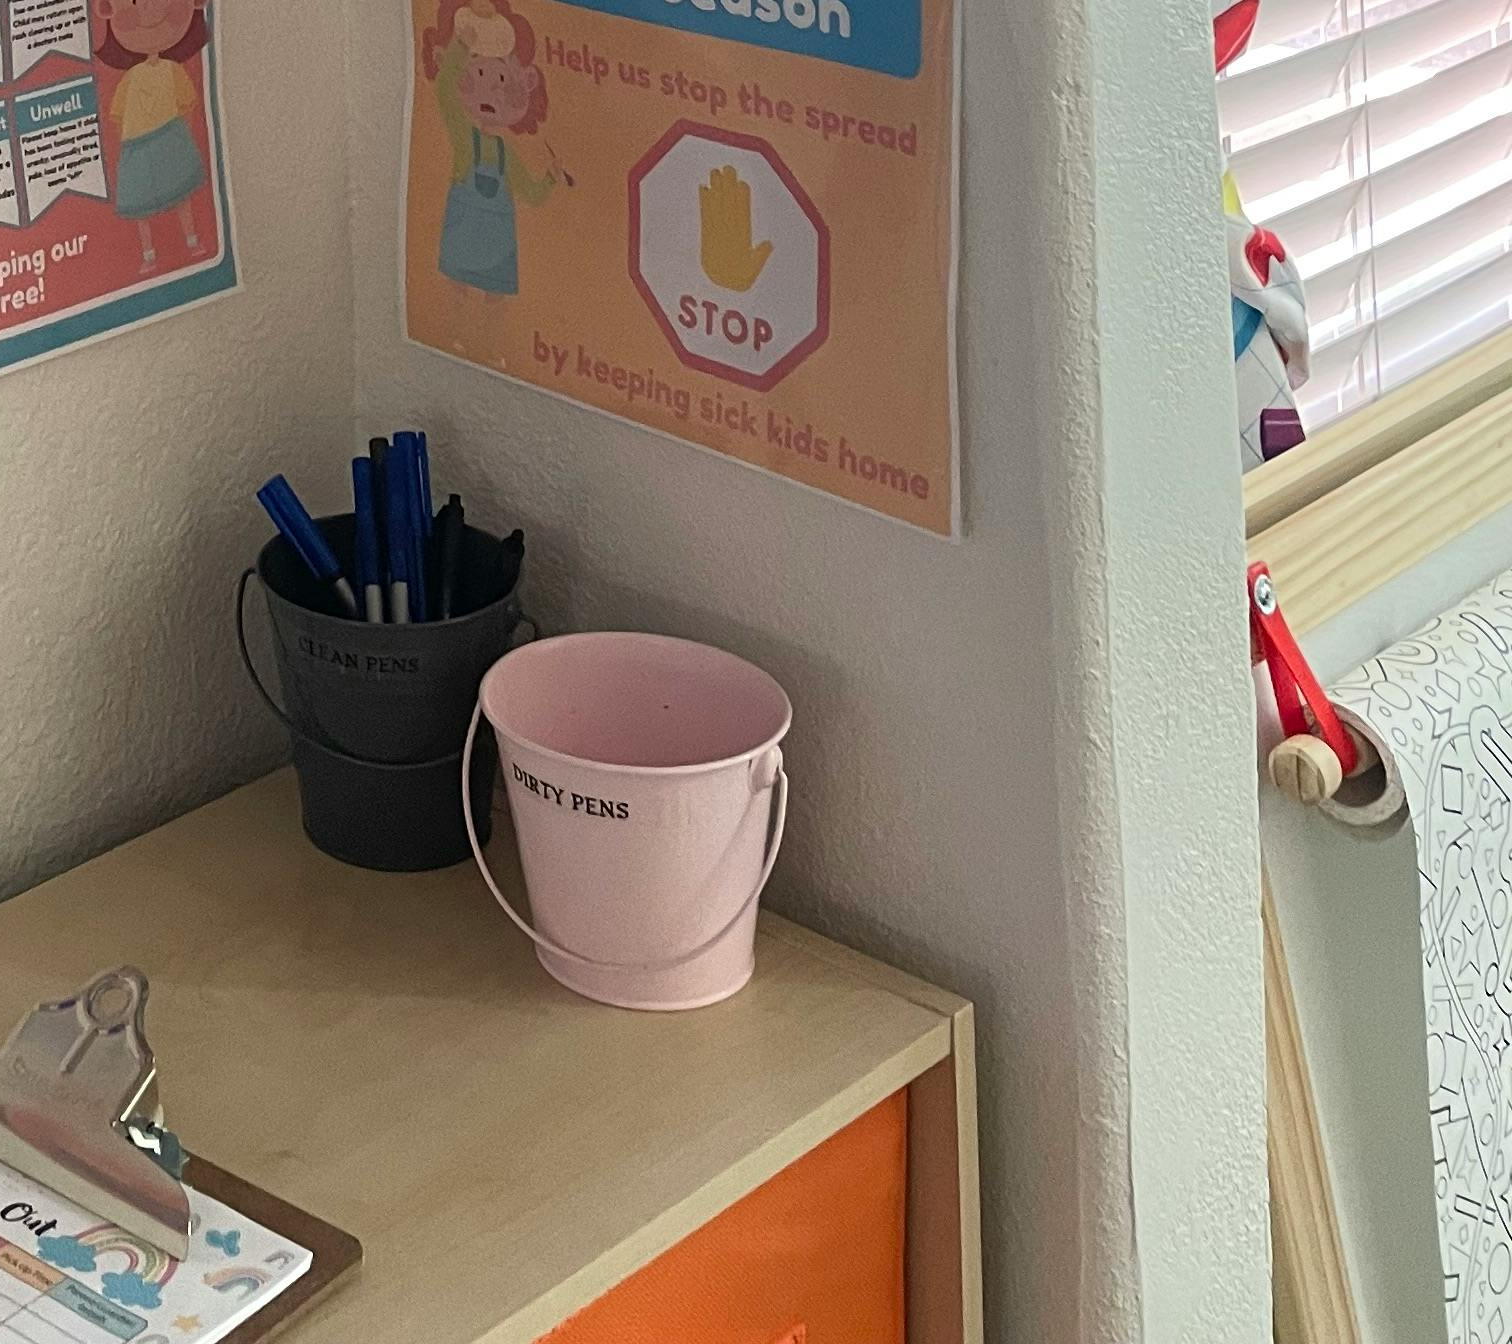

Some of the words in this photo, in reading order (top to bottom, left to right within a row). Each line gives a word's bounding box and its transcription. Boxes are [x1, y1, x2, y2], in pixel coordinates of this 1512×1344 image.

[30, 93, 83, 122] Unwell
[544, 36, 609, 82] Help
[619, 61, 650, 89] us
[660, 71, 727, 114] stop
[739, 82, 793, 123] the
[805, 106, 918, 157] spread
[51, 235, 88, 262] our
[678, 294, 773, 351] STOP
[533, 331, 568, 375] by
[576, 345, 689, 420] keeping
[699, 391, 759, 437] sick
[767, 409, 828, 462] kids
[838, 437, 929, 500] home
[298, 636, 359, 670] CLEAN
[366, 655, 419, 673] PENS
[513, 763, 564, 805] DIRTY
[571, 792, 630, 819] PENS
[0, 1202, 59, 1236] Out
